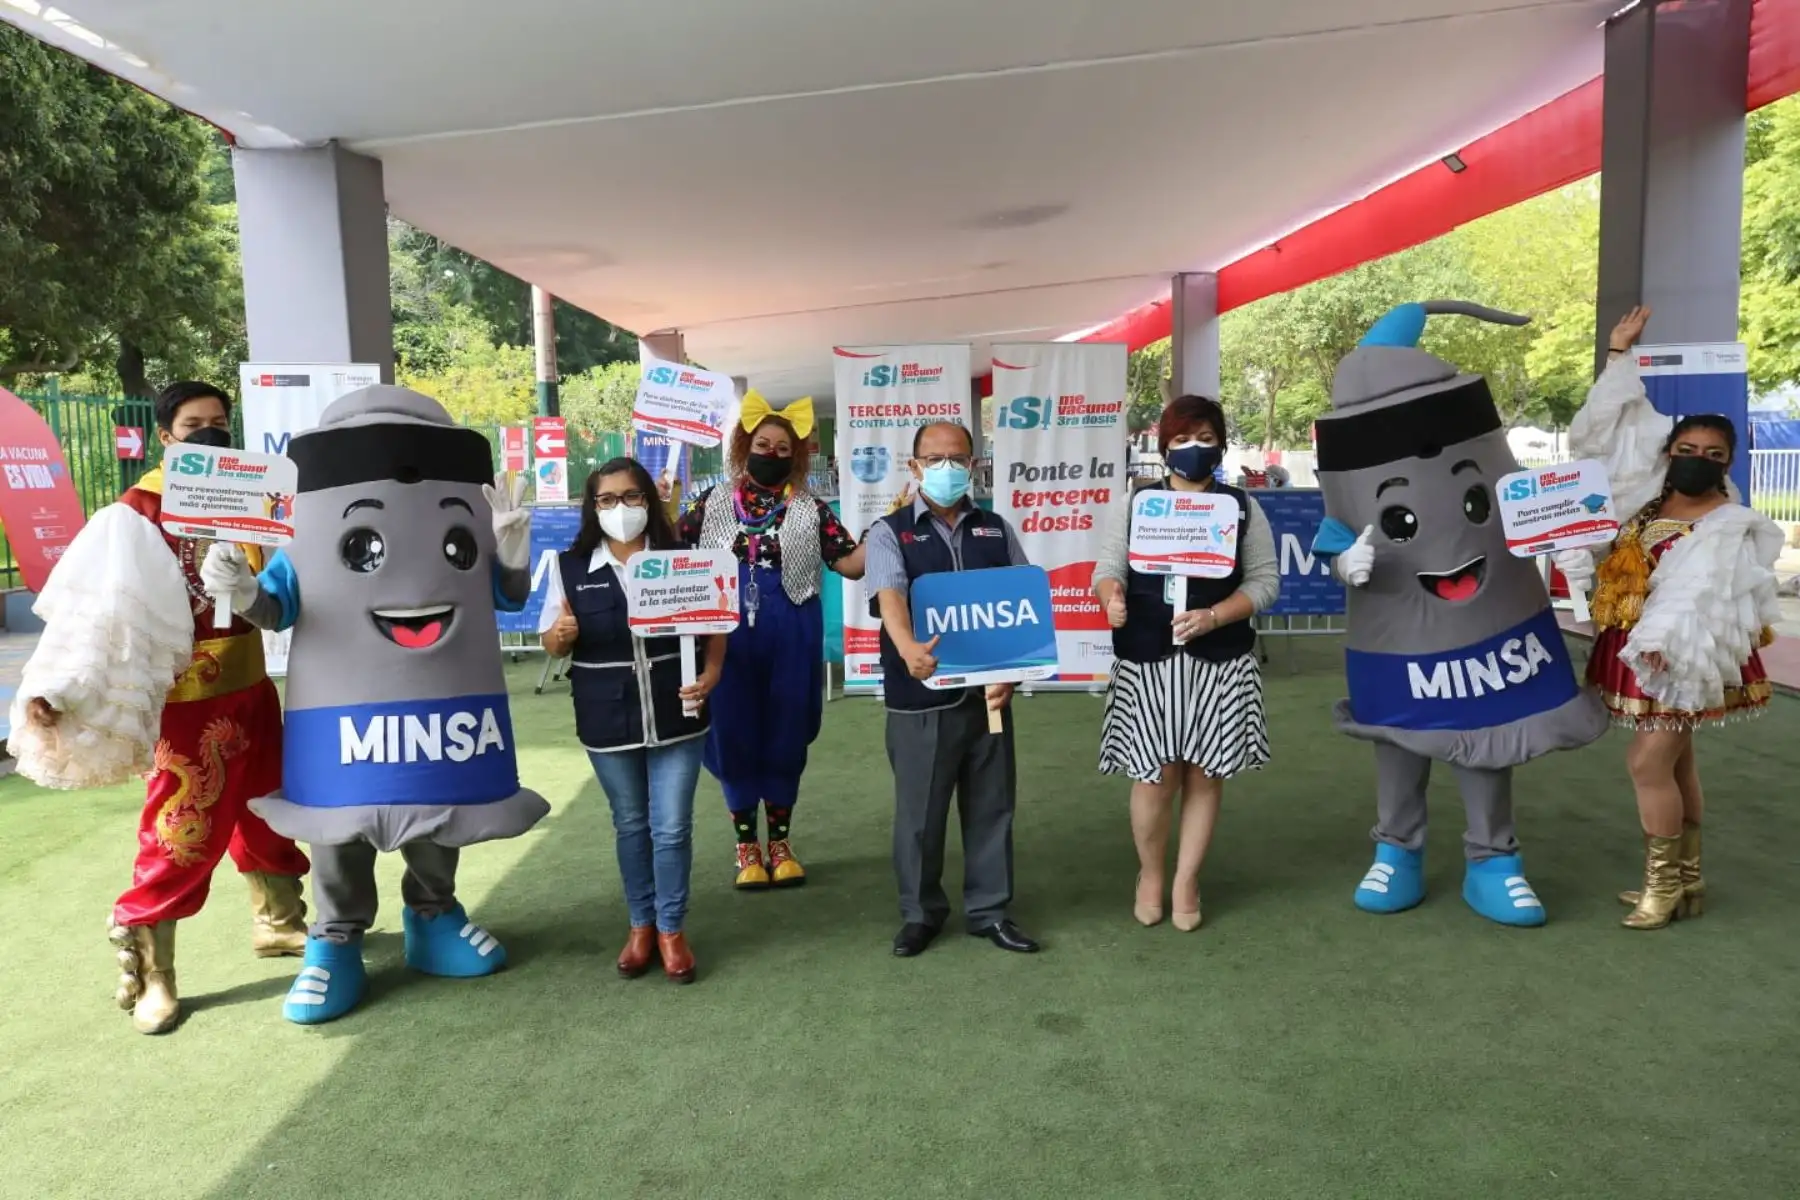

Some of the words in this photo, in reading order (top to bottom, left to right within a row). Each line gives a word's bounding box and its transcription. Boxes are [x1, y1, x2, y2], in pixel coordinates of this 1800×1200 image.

[848, 404, 912, 417] TERCERA
[917, 403, 961, 416] DOSIS
[1058, 401, 1122, 416] vacuno!
[849, 419, 893, 428] CONTRA
[896, 418, 910, 427] LA
[1082, 414, 1117, 425] dosis
[9, 447, 48, 460] VACUNA
[3, 464, 26, 489] ES
[1008, 461, 1084, 483] Ponte
[1089, 456, 1115, 479] la
[170, 483, 193, 492] Para
[1012, 487, 1110, 509] tercera
[1518, 507, 1539, 518] Para
[1541, 498, 1576, 514] cumplir
[1022, 508, 1093, 534] dosis
[1512, 513, 1552, 528] nuestras
[1554, 506, 1580, 518] metas
[641, 587, 667, 597] Para
[669, 584, 709, 595] alentar
[649, 598, 659, 606] la
[662, 594, 711, 606] selección
[926, 598, 1039, 635] MINSA
[1407, 632, 1553, 699] MINSA
[339, 707, 505, 765] MINSA
